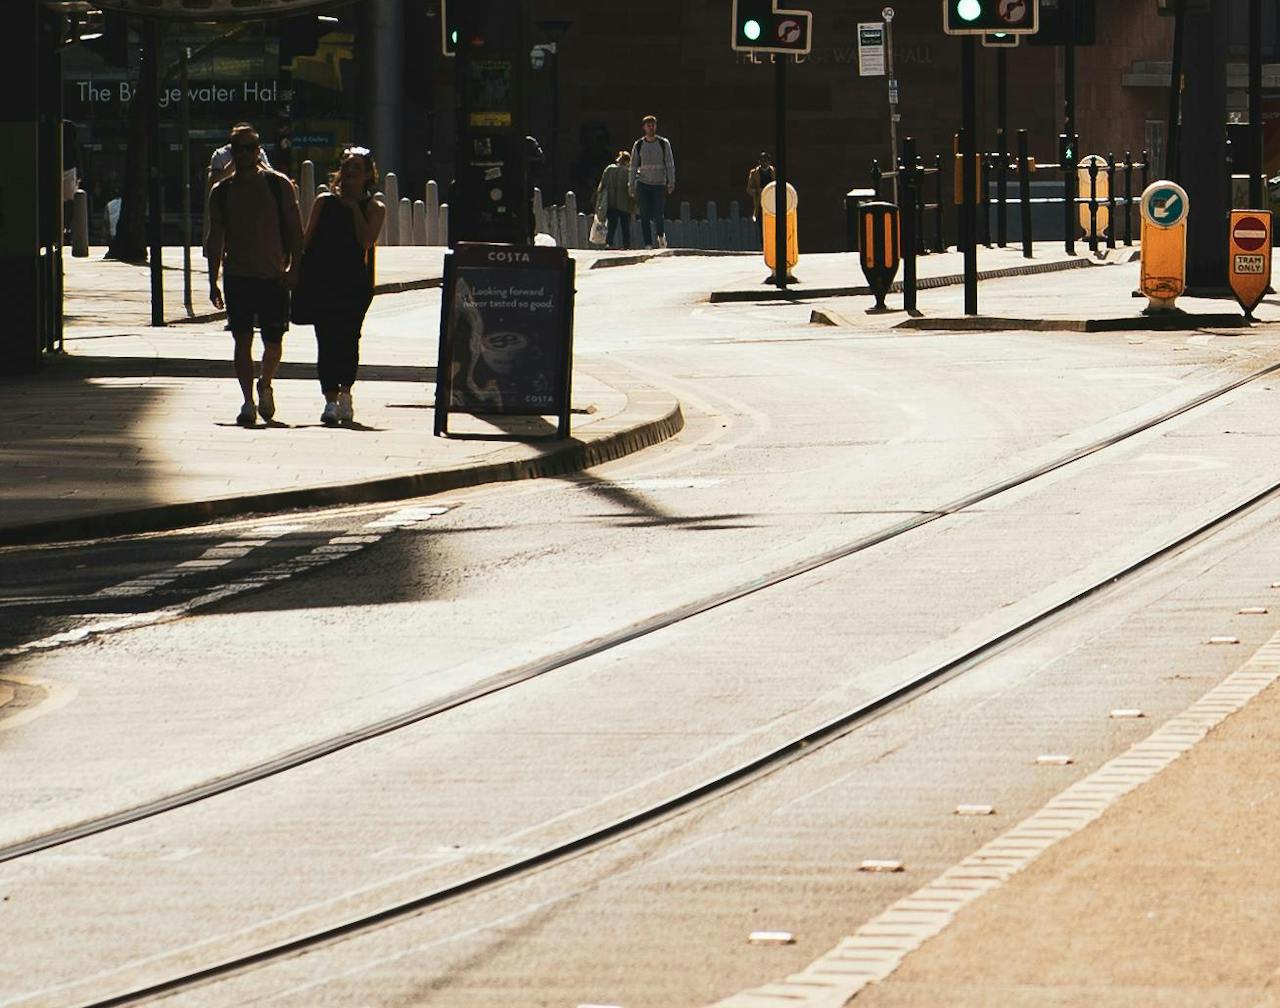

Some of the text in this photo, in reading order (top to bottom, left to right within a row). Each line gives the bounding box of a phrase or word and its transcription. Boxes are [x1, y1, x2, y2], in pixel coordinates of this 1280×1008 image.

[77, 81, 111, 102] The
[243, 79, 279, 102] Hal
[487, 251, 530, 263] COSTA
[1238, 256, 1261, 264] TRAM
[1238, 264, 1261, 272] ONLY
[472, 286, 544, 298] Looking forward
[489, 299, 517, 308] tasted
[525, 395, 553, 403] COSTA
